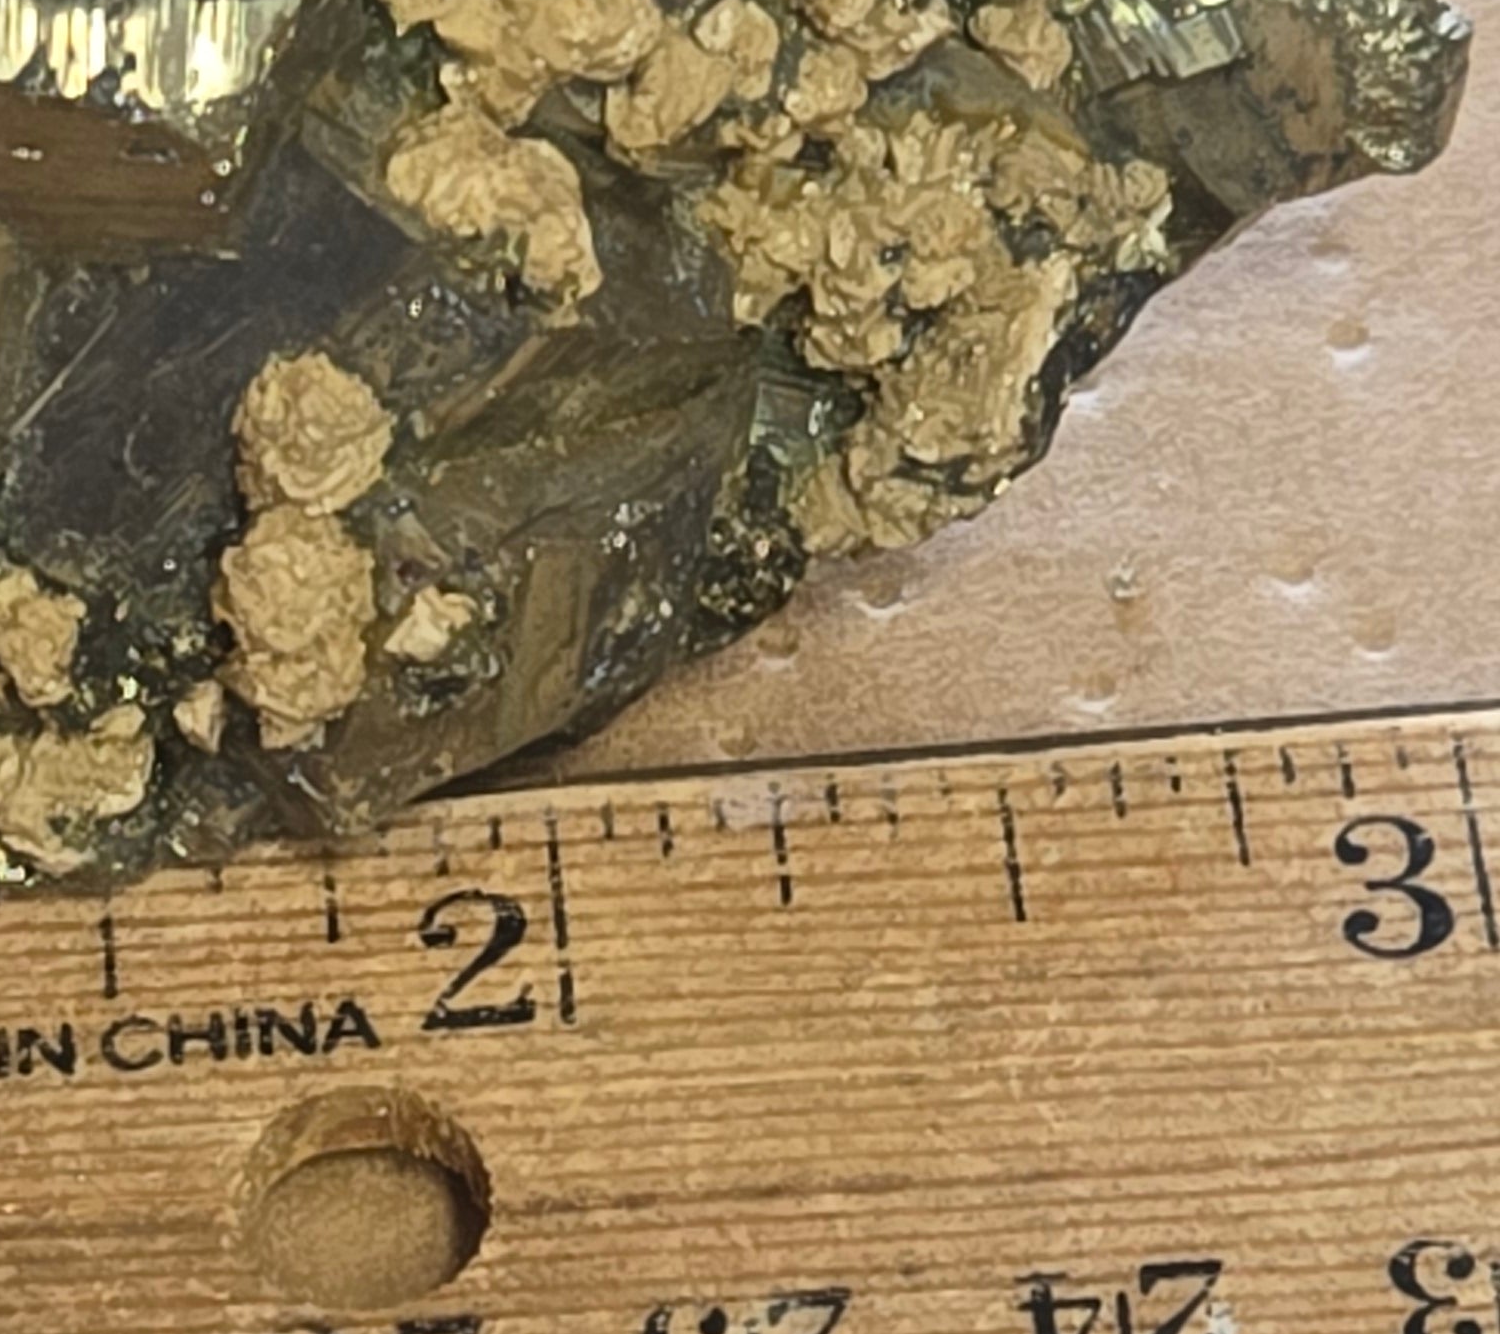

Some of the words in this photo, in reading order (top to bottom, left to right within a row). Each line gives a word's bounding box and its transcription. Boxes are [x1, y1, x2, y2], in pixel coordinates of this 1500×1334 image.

[1332, 815, 1455, 958] 3
[419, 889, 534, 1030] 2
[100, 1000, 381, 1071] CHINA
